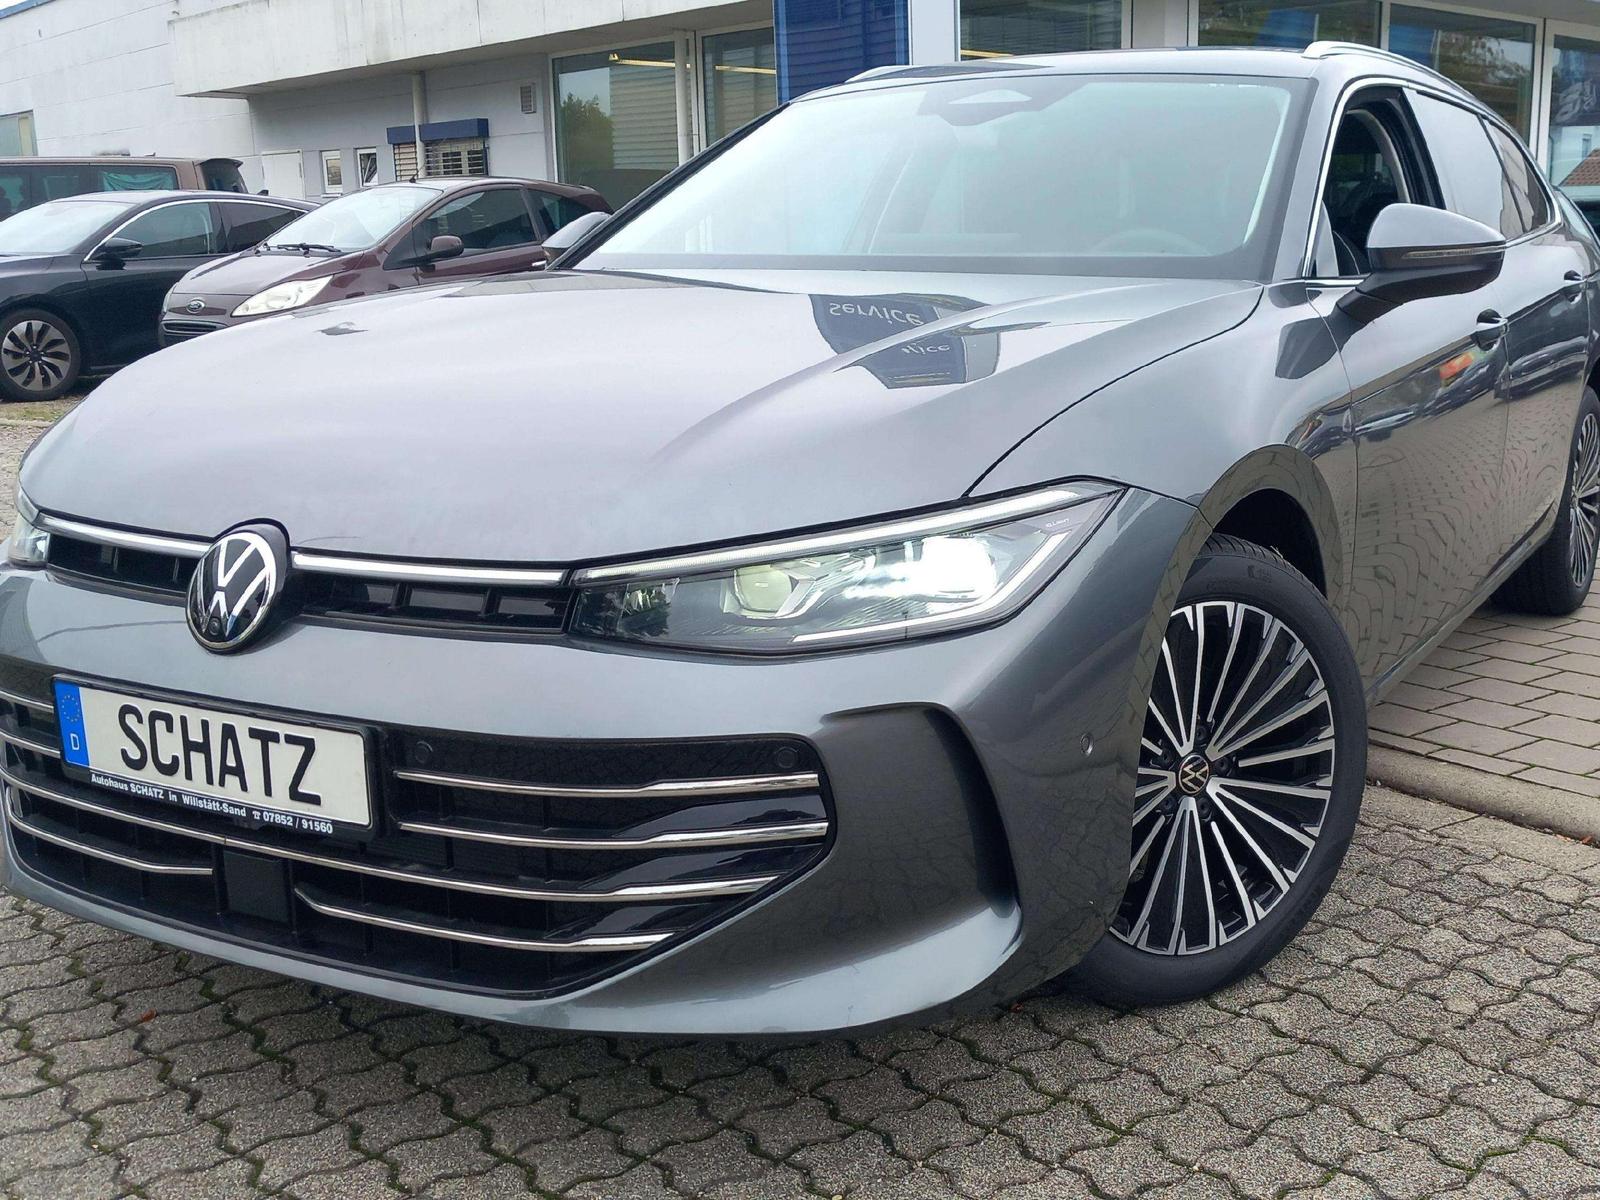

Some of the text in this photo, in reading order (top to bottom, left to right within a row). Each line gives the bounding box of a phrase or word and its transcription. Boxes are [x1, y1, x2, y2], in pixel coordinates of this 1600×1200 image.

[70, 733, 80, 750] D
[117, 703, 322, 806] SCHATZ
[91, 773, 129, 791] Autohaus
[130, 783, 165, 799] SCHATZ
[262, 811, 294, 826] 07852
[301, 819, 333, 834] 91560
